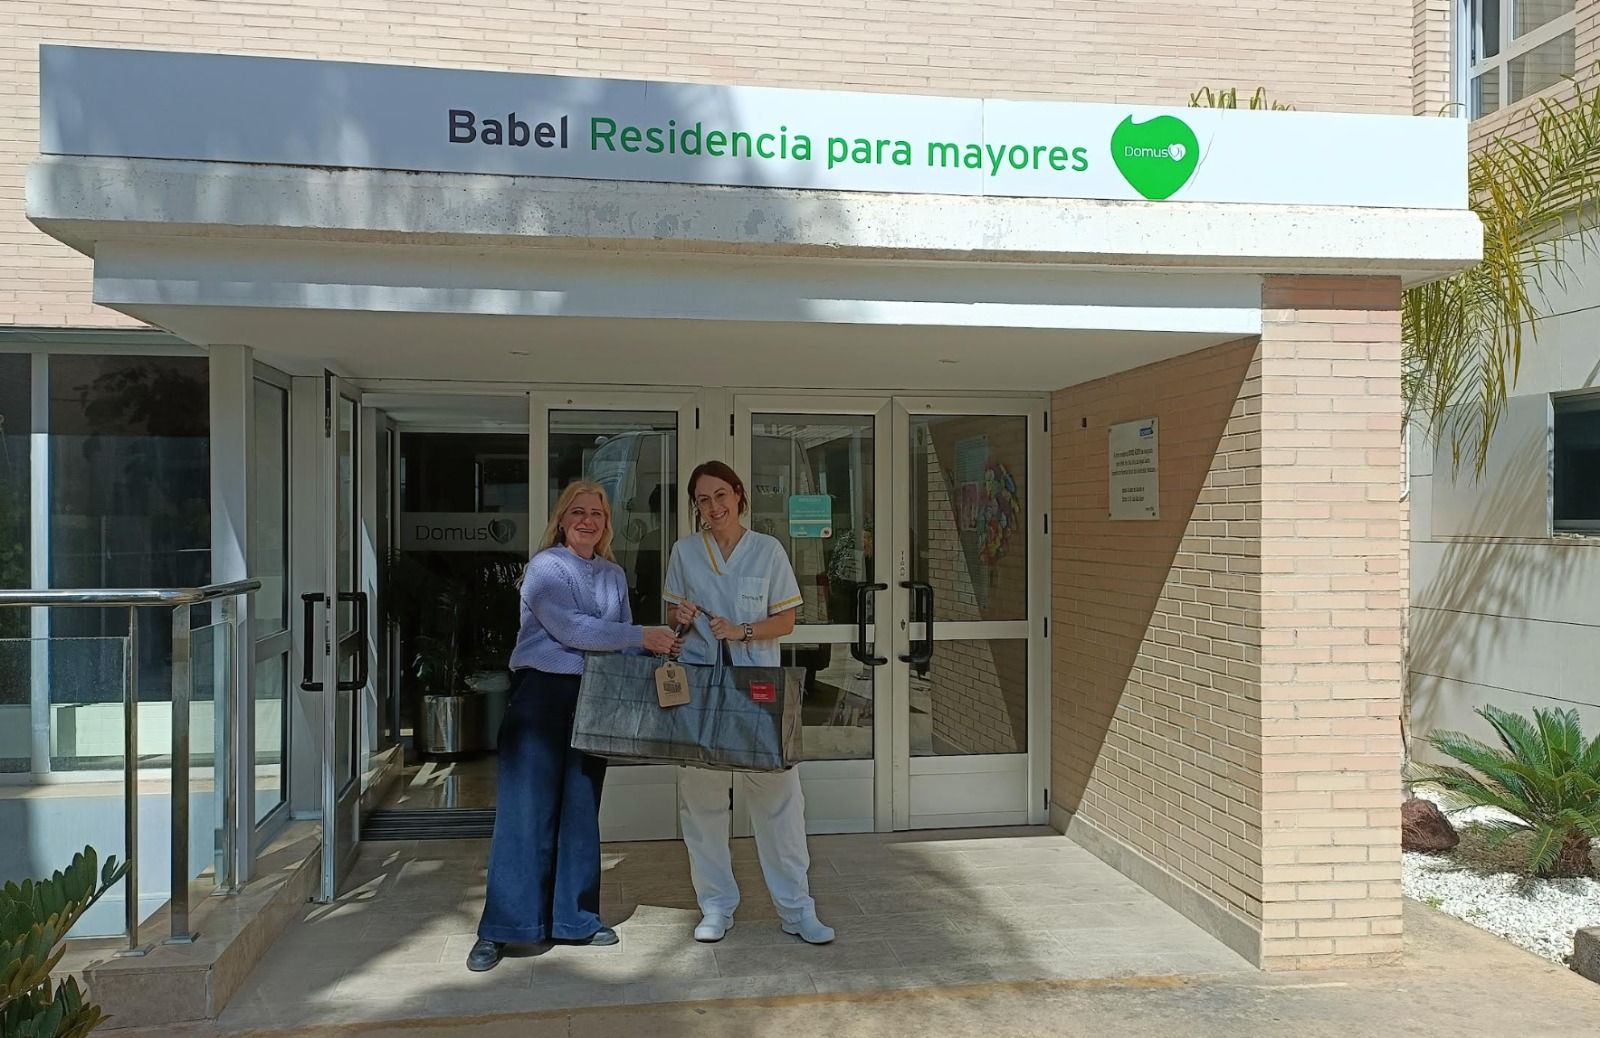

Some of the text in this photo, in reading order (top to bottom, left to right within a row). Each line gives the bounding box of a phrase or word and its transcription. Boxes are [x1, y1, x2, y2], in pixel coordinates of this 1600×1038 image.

[449, 109, 1089, 177] Babel Residencia para mayores
